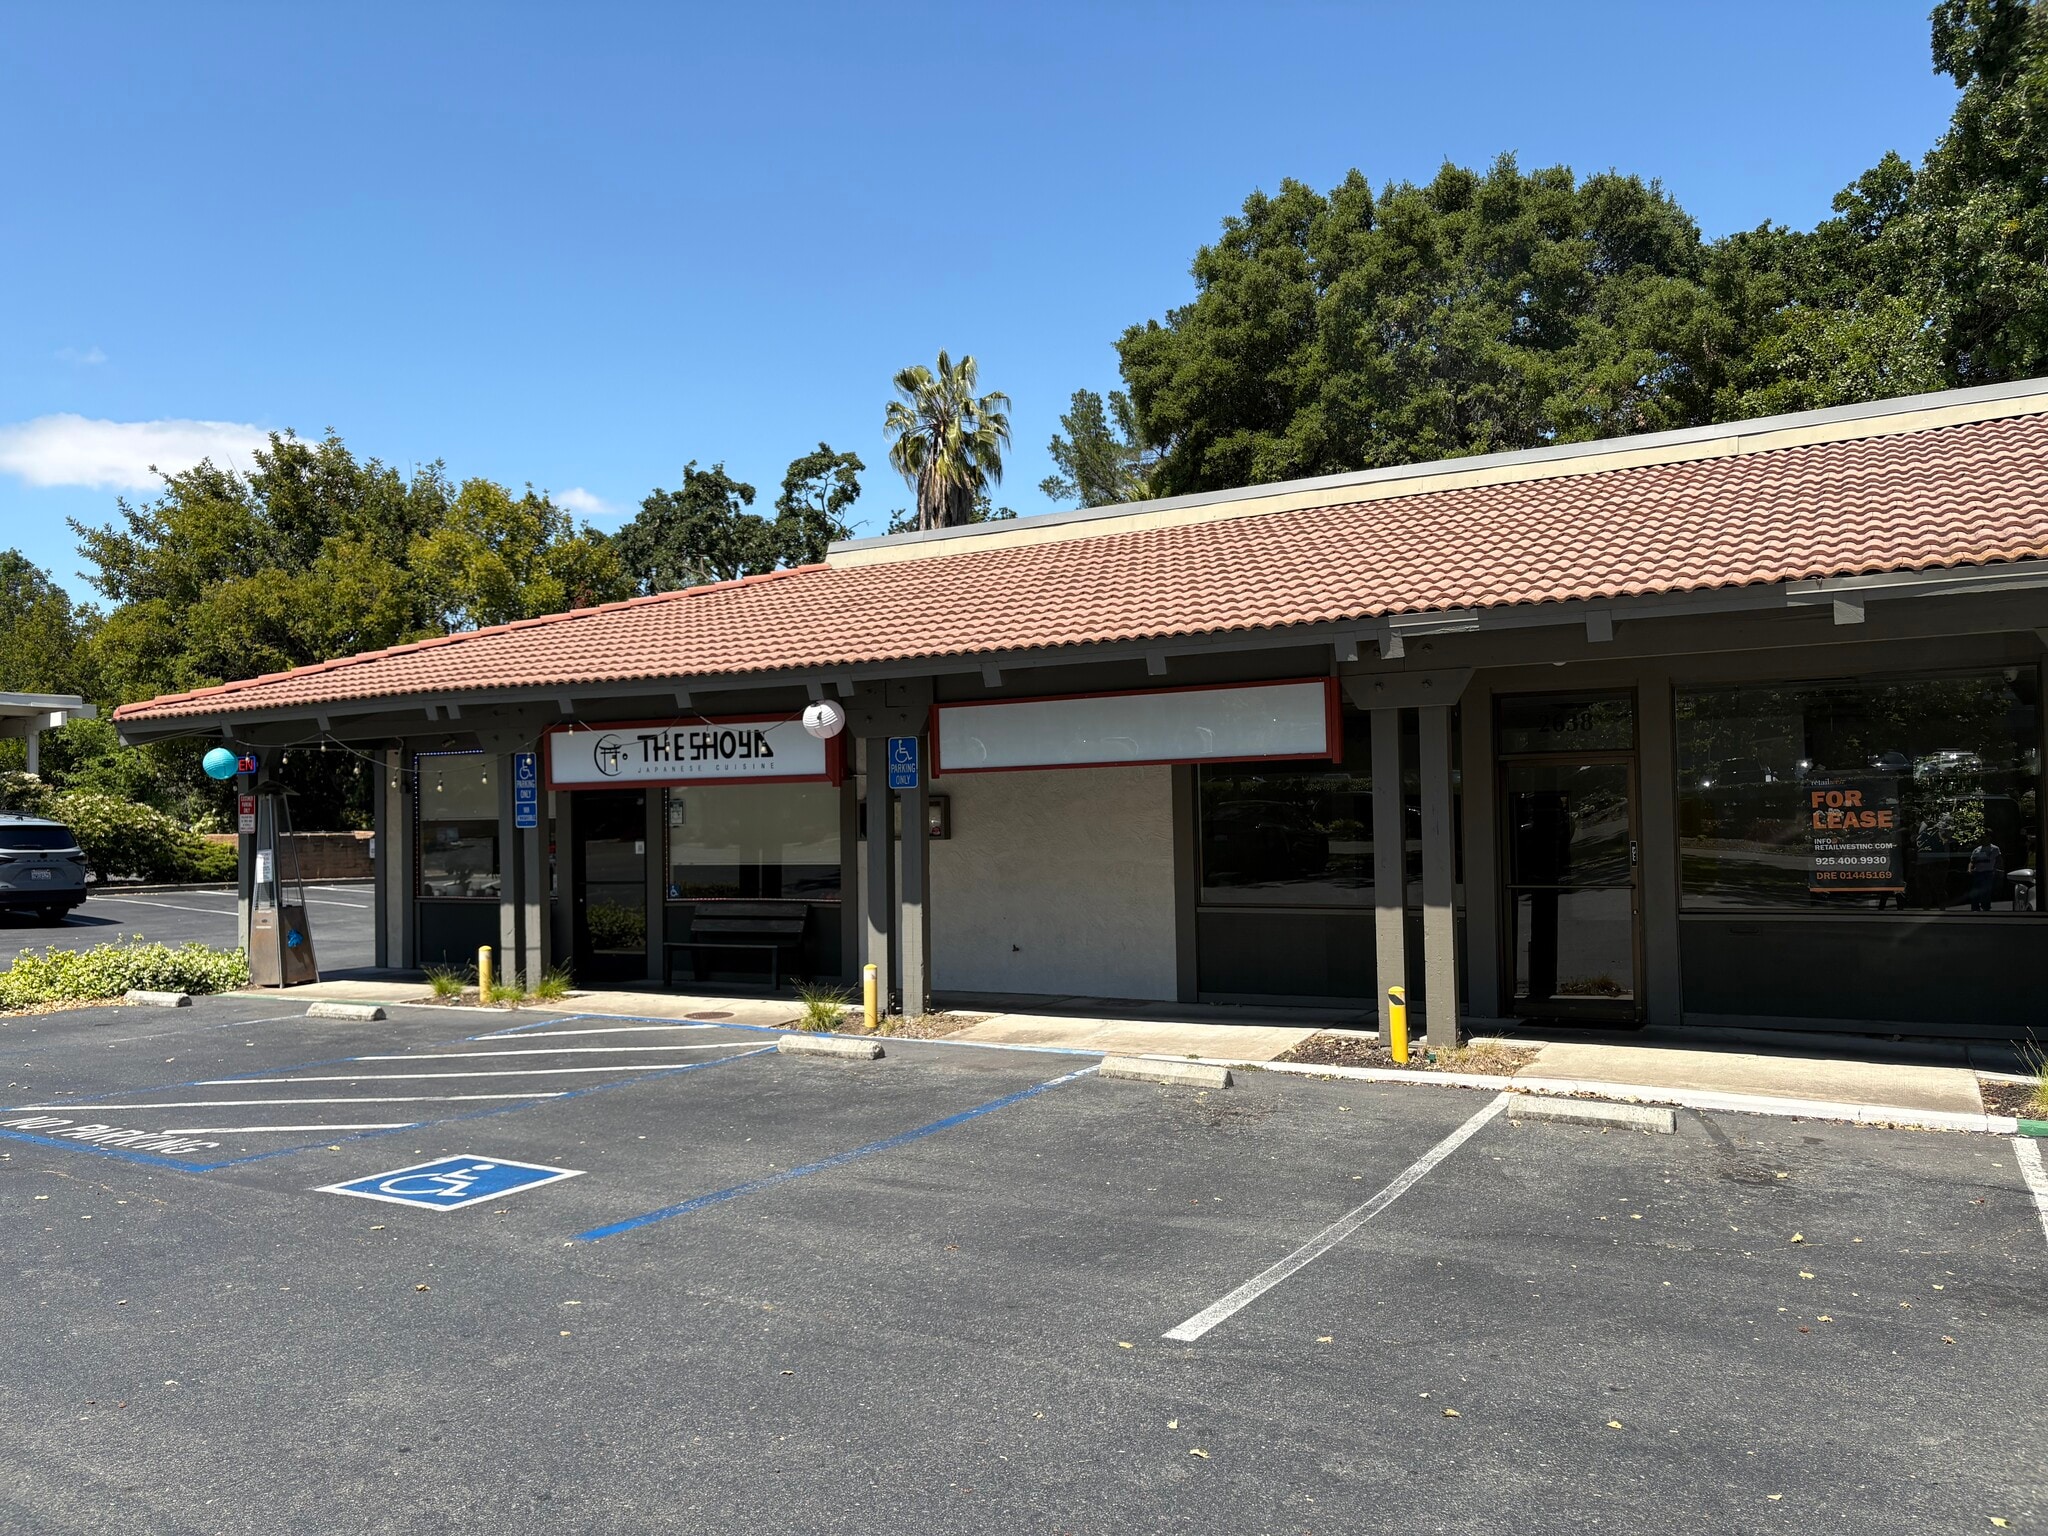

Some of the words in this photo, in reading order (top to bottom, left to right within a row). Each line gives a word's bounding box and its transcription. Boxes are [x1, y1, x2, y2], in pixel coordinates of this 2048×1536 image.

[1538, 712, 1593, 733] 2638
[238, 759, 253, 771] EN
[638, 765, 702, 774] JAPANESE
[716, 762, 775, 771] CUISINE
[891, 763, 915, 773] PARKING
[896, 775, 911, 785] ONLY
[1811, 790, 1862, 808] FOR
[1812, 810, 1893, 829] LEASE
[1815, 856, 1887, 865] 925.400.9930
[1816, 872, 1837, 880] DRE
[1840, 871, 1892, 879] 01445169
[0, 1116, 74, 1130] NO
[46, 1124, 220, 1154] PARKING
